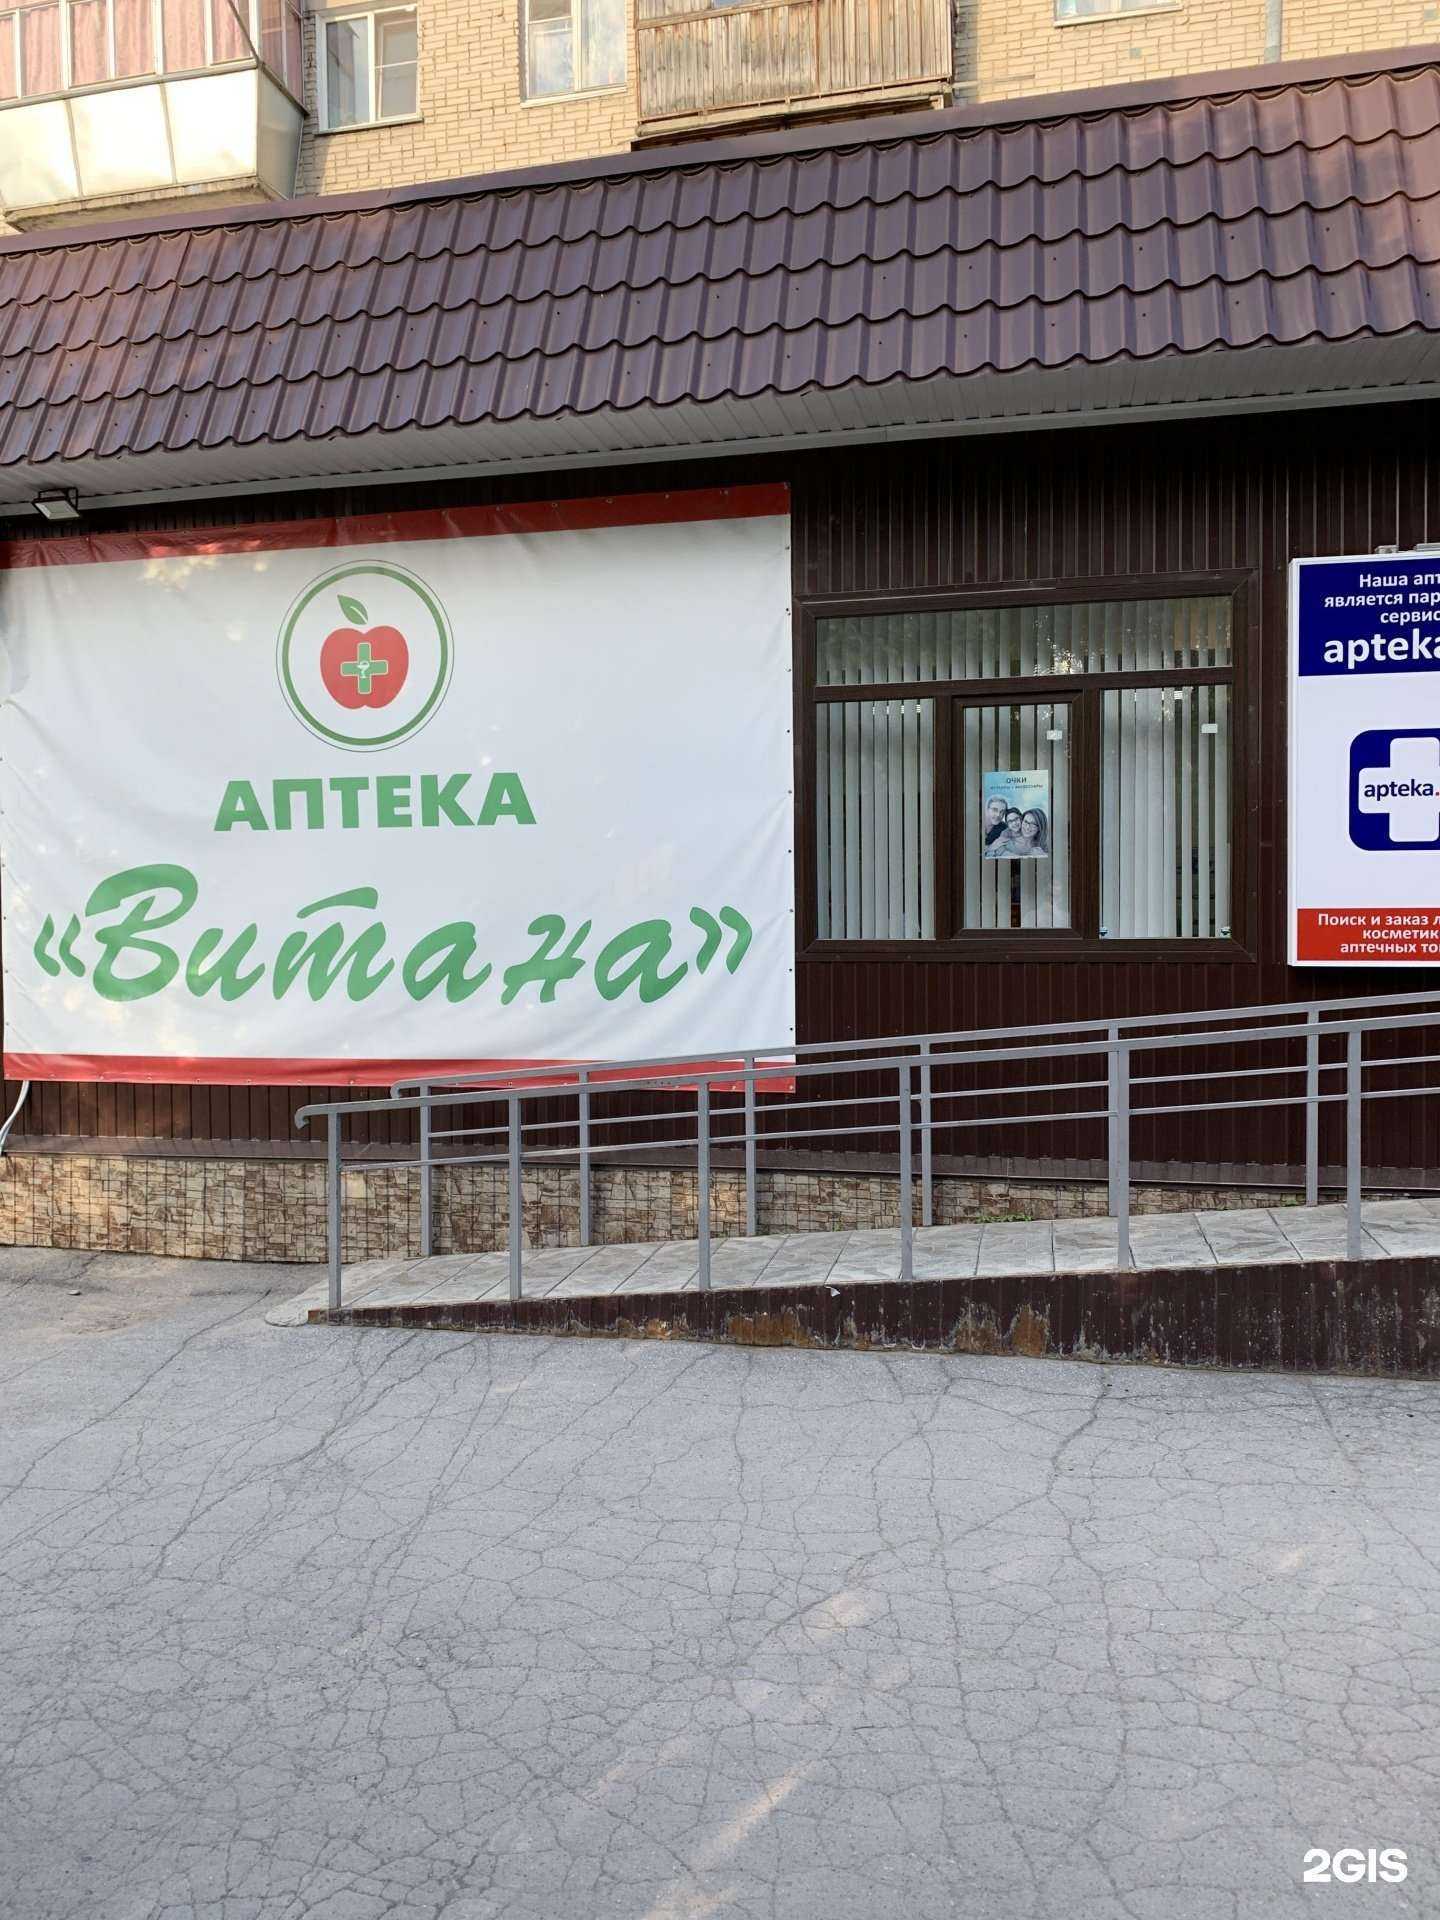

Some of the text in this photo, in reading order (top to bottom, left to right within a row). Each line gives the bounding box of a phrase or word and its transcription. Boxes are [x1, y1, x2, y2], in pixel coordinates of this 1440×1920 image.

[1359, 574, 1408, 588] Наша
[1324, 591, 1440, 608] является пар
[1380, 610, 1440, 626] сервис
[213, 772, 537, 833] АПТЕКА
[1318, 913, 1367, 926] Поиск
[1371, 915, 1381, 925] и
[1385, 915, 1429, 926] заказ
[34, 863, 753, 1004] «Витана»
[1362, 929, 1440, 939] косметик
[1340, 943, 1440, 953] аптечных то
